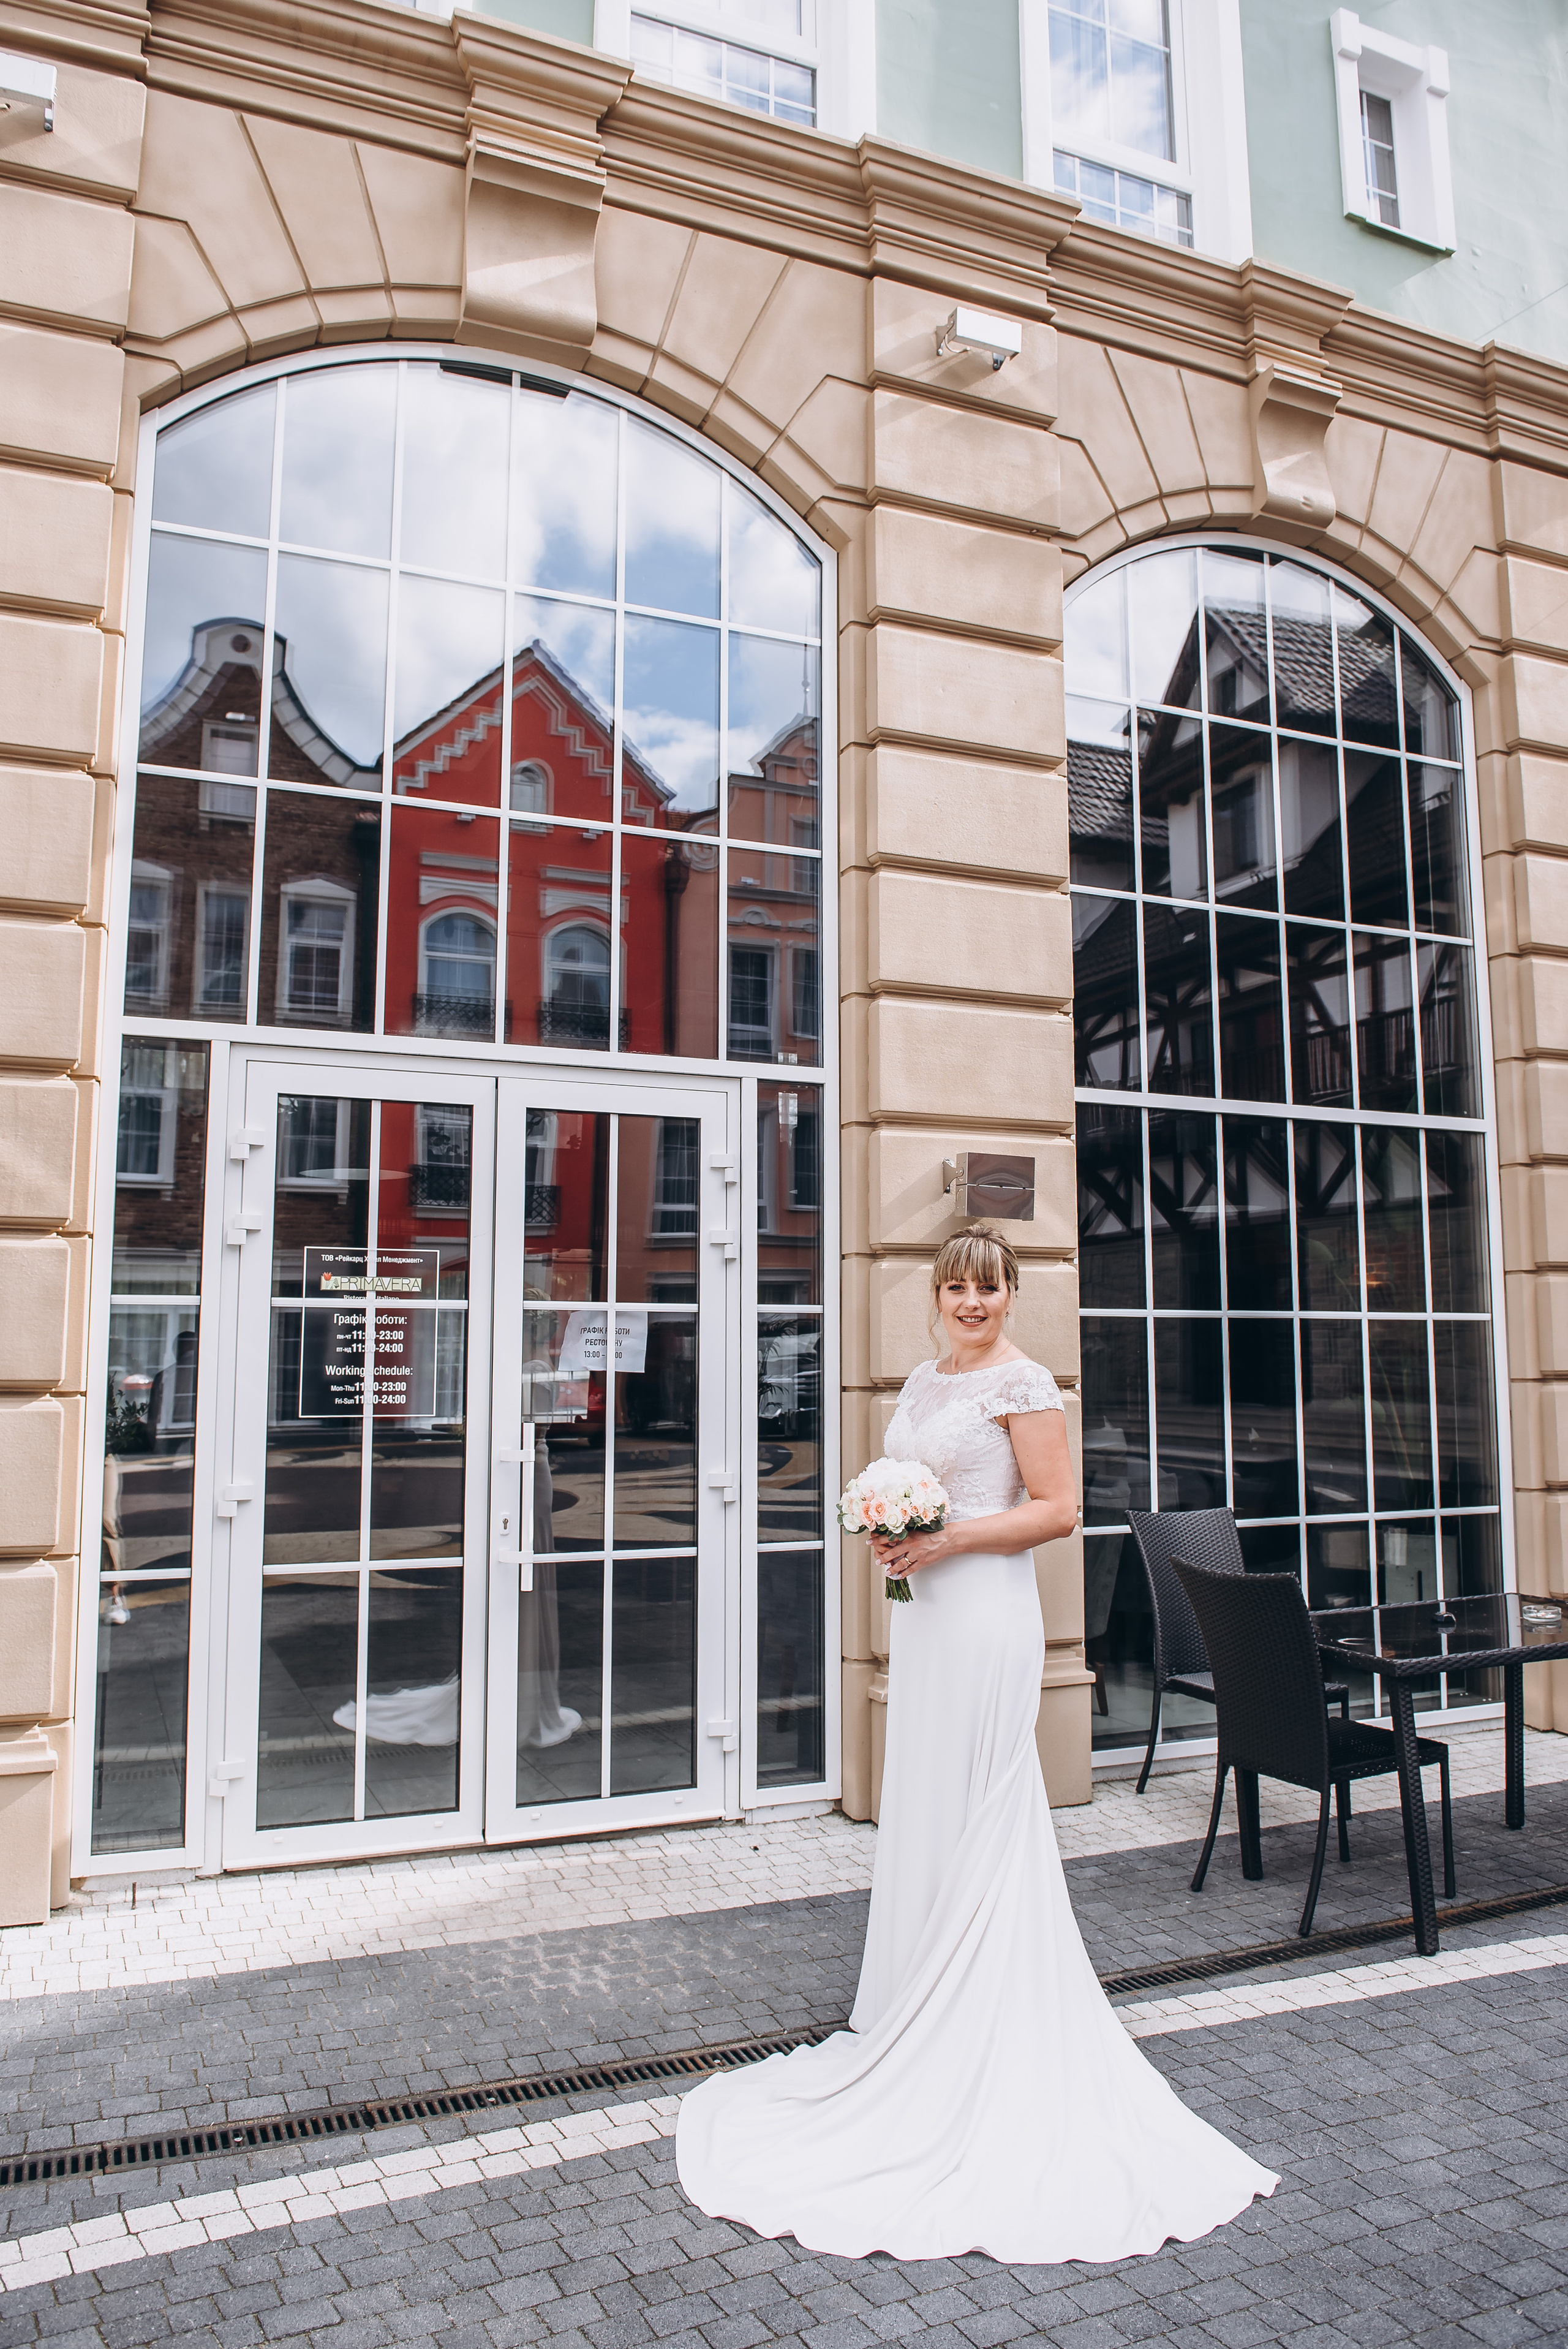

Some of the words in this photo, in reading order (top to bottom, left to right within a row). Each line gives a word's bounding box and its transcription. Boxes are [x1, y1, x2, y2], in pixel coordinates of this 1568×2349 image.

[335, 1255, 363, 1263] «Рейкарц
[382, 1255, 423, 1264] Менеджмент»
[340, 1276, 422, 1292] PRIMAVERA
[334, 1313, 368, 1326] Графік
[325, 1365, 366, 1377] Working
